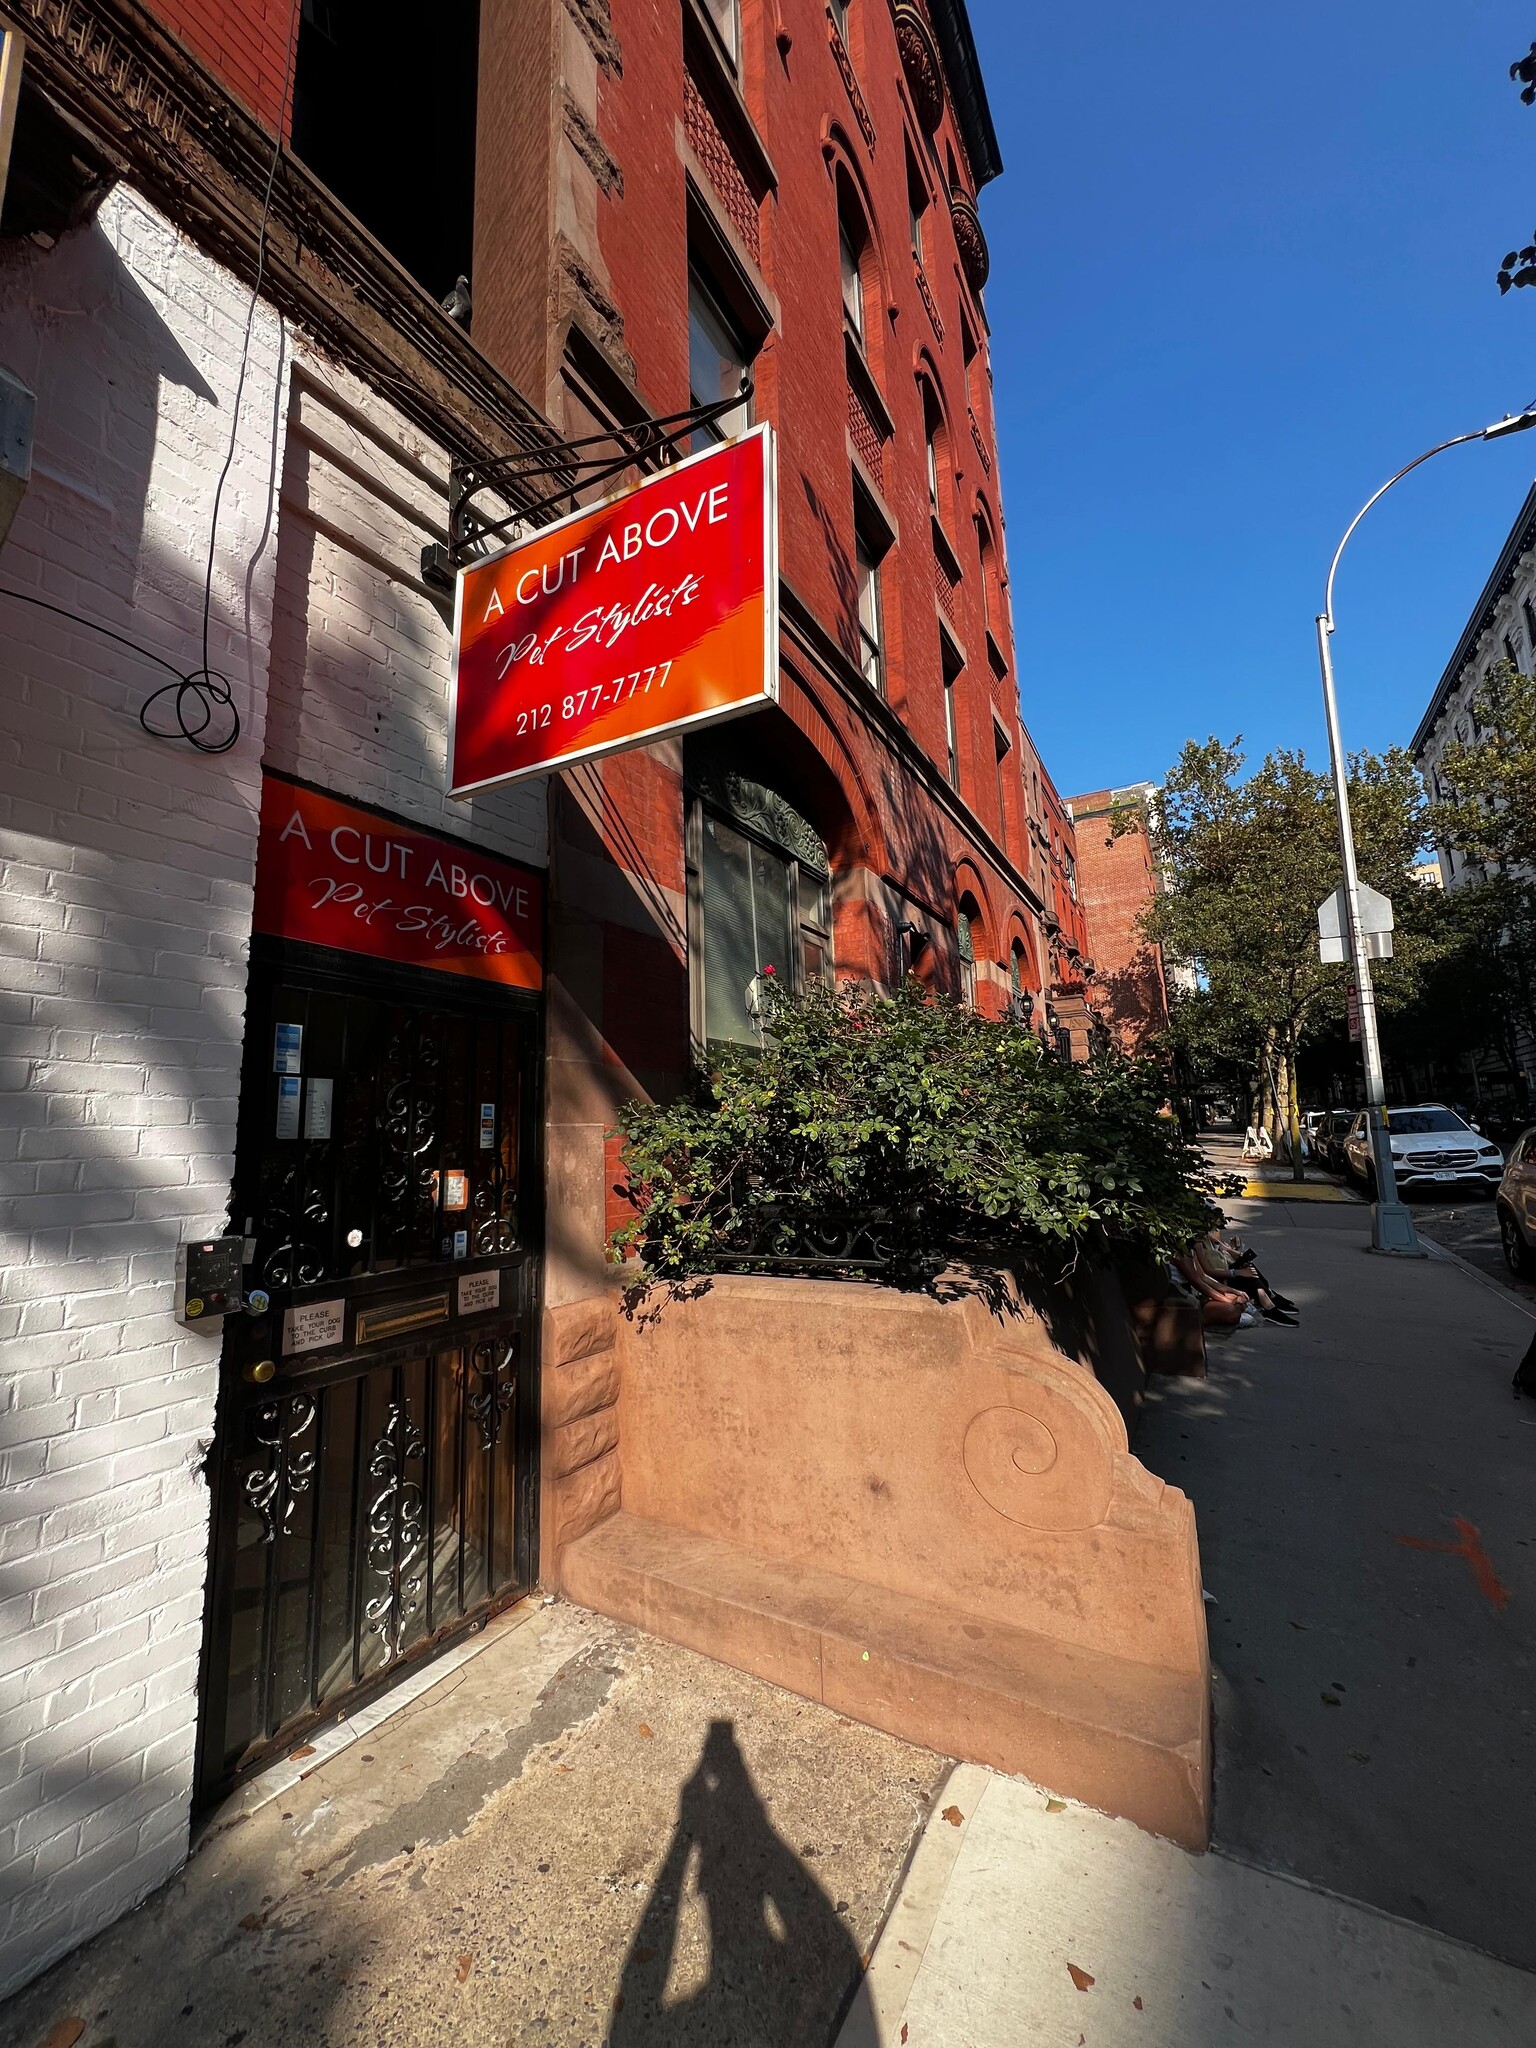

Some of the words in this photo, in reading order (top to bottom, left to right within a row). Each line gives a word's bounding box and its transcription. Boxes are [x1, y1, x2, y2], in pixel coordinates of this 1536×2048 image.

[483, 588, 504, 623] A
[516, 547, 585, 606] CUT
[595, 482, 728, 573] ABOVE
[496, 627, 571, 680] Pet
[565, 573, 704, 653] Stylists
[516, 704, 551, 736] 212
[562, 661, 673, 720] 877-7777
[279, 809, 312, 850] A
[330, 826, 413, 879] CUT
[425, 859, 528, 918] ABOVE
[308, 877, 400, 925] Pet
[396, 906, 510, 954] Stylists
[469, 1279, 490, 1288] PLEASE
[288, 1325, 304, 1334] TAKE
[308, 1321, 325, 1329] YOUR
[328, 1317, 340, 1325] DOG
[300, 1310, 330, 1322] PLEASE
[303, 1329, 316, 1337] THE
[319, 1325, 337, 1333] CURB
[291, 1339, 305, 1347] AND
